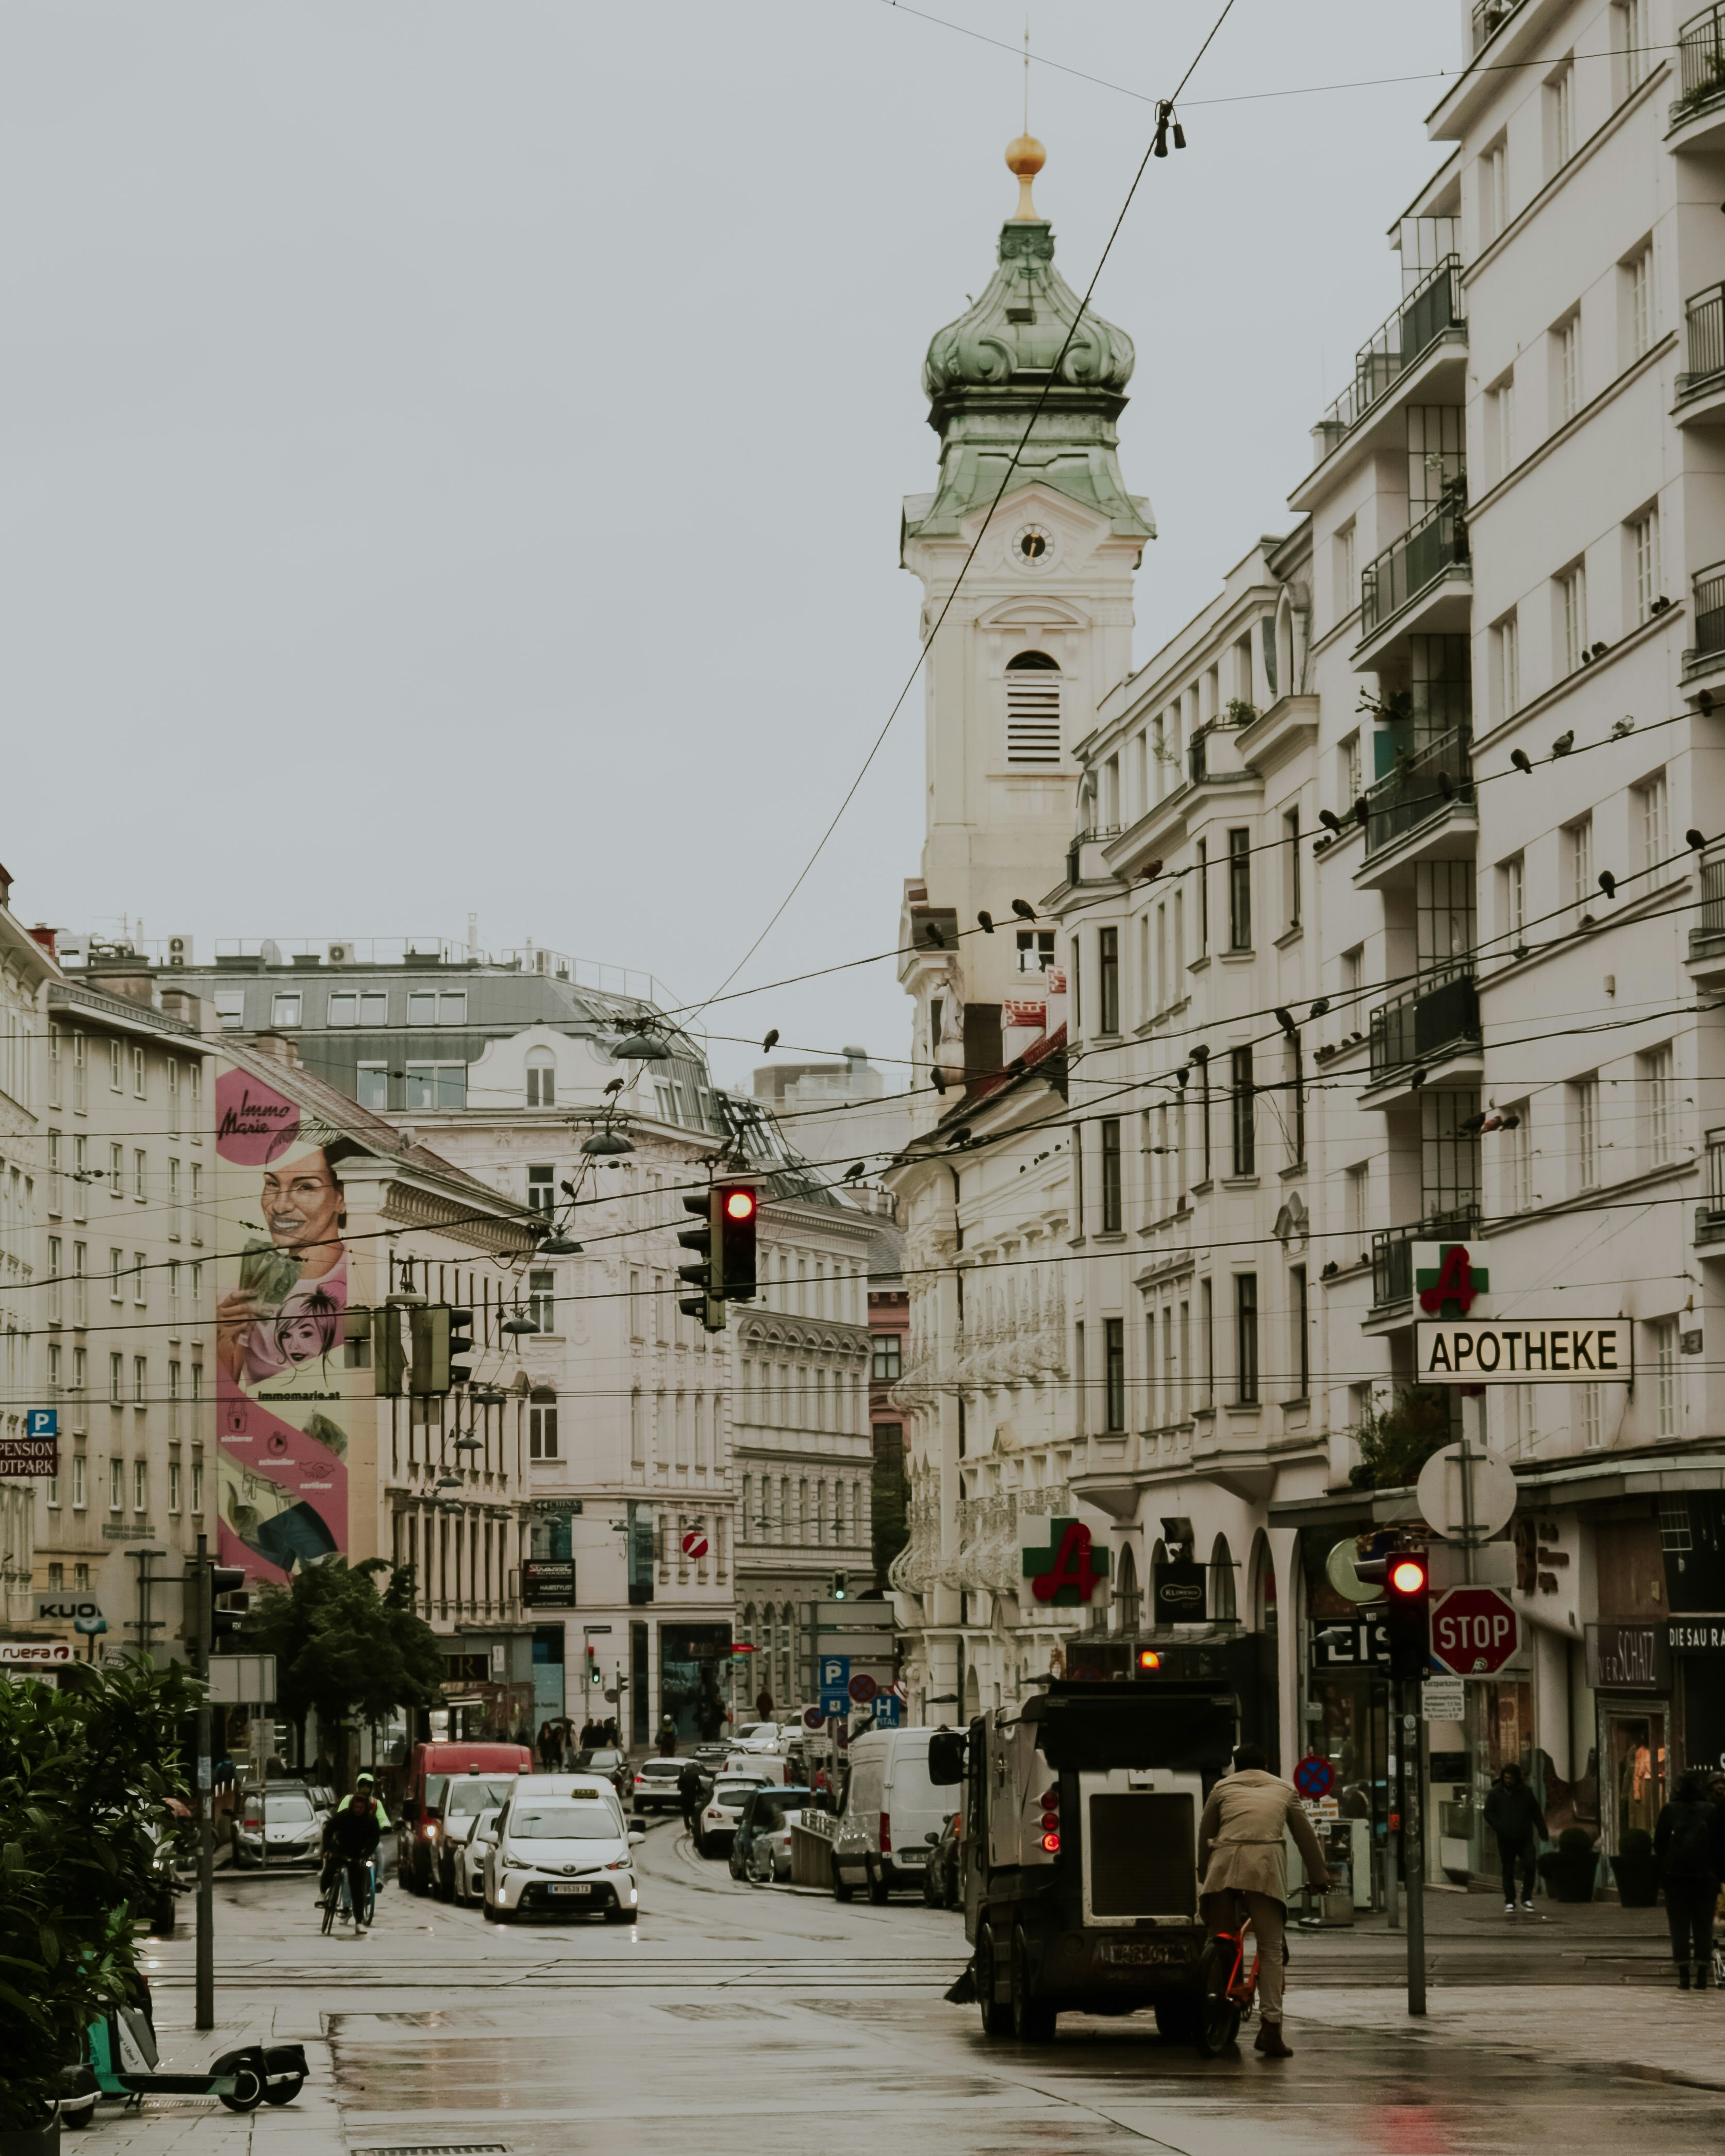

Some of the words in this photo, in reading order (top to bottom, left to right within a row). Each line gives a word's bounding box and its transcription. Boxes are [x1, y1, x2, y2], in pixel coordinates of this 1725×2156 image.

[240, 1090, 289, 1117] Immo
[218, 1107, 269, 1140] Marie
[1429, 1330, 1618, 1372] APOTHEKE
[258, 1391, 340, 1400] immomarie.at
[35, 1413, 49, 1431] P
[1439, 1615, 1510, 1649] STOP
[1669, 1628, 1684, 1646] DIE
[1687, 1628, 1706, 1646] SAU
[3, 1649, 51, 1659] ruefa
[826, 1665, 842, 1685] P
[876, 1699, 891, 1716] H
[877, 1718, 897, 1726] PITAL
[1315, 1825, 1330, 1833] fang
